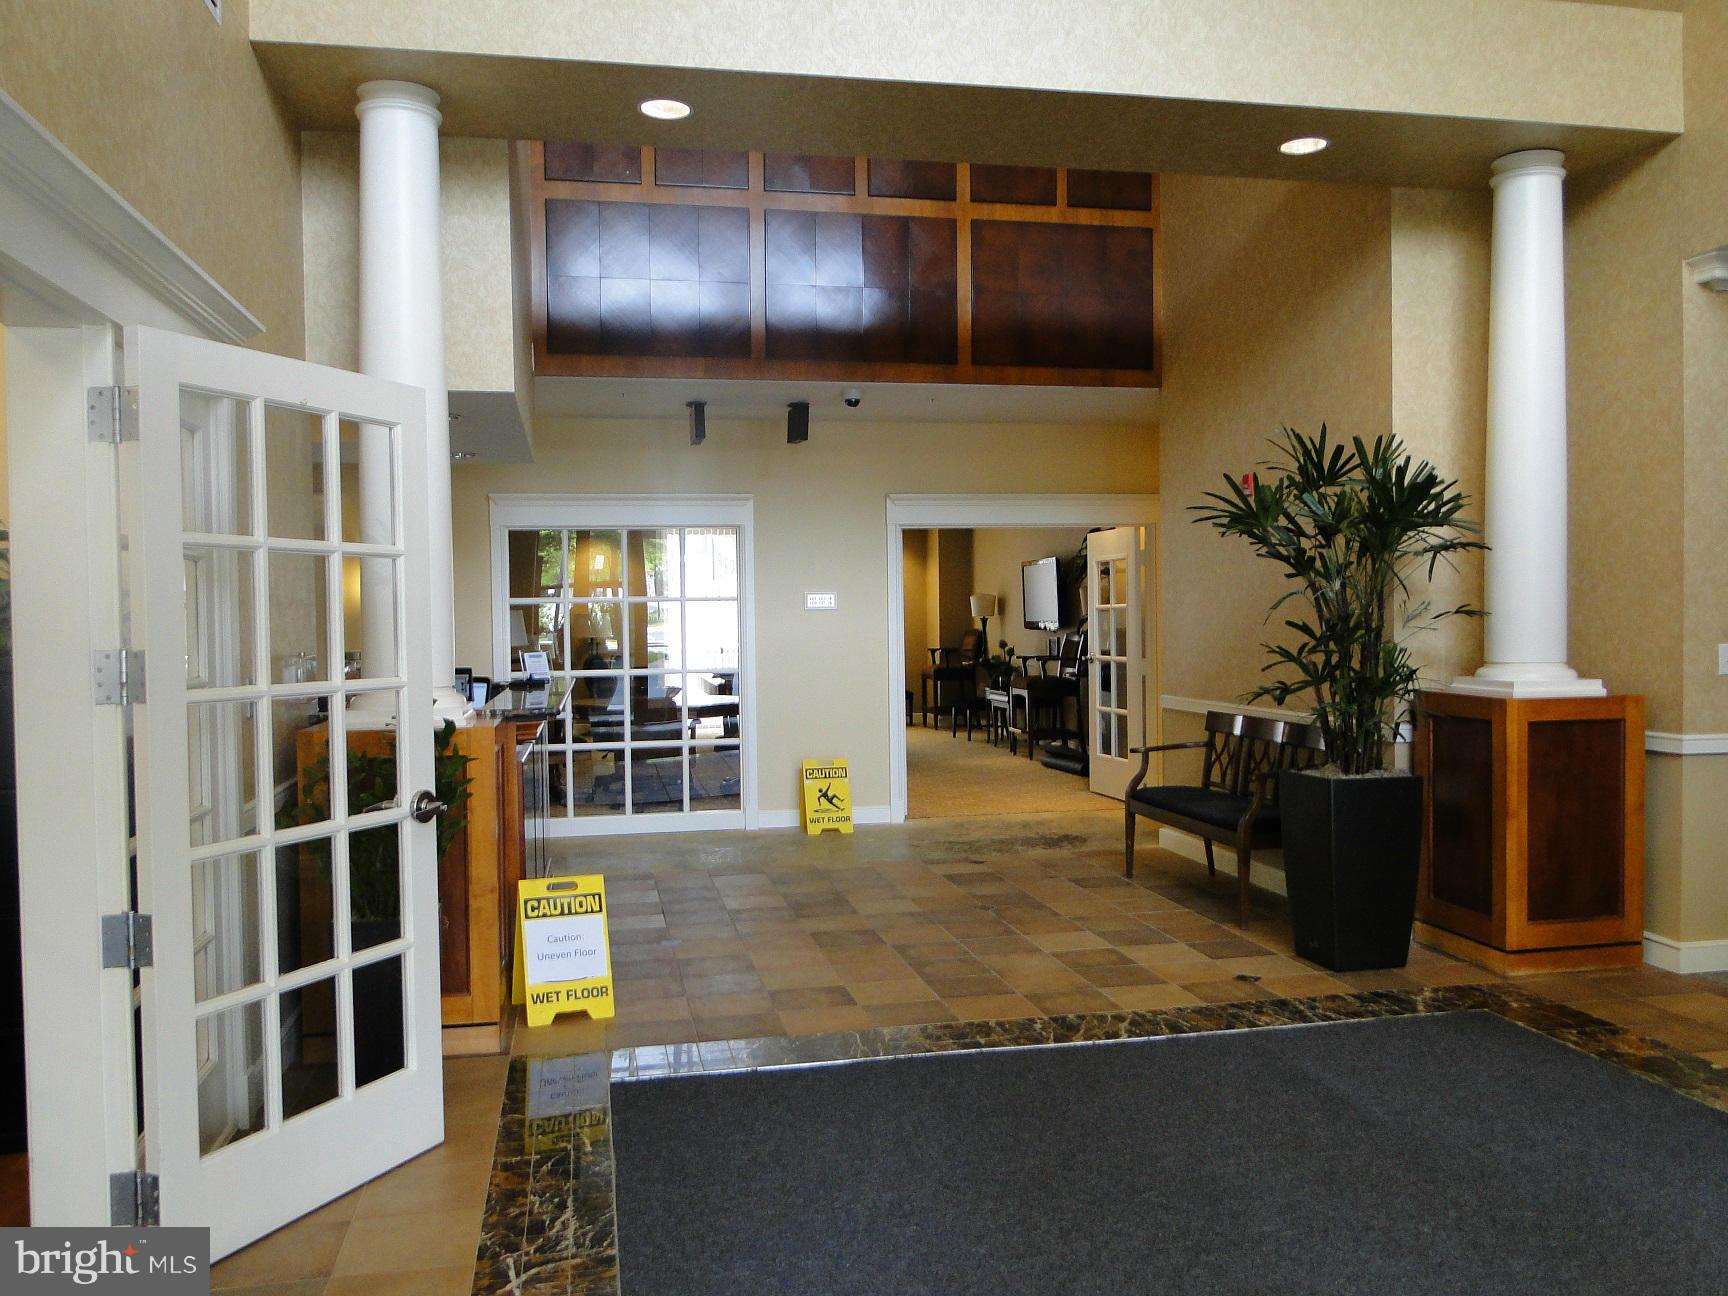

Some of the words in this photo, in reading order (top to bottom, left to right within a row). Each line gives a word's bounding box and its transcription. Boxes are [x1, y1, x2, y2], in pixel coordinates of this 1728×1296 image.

[806, 767, 846, 778] CAUTION
[526, 894, 600, 918] CAUTION
[537, 951, 572, 961] Uneven
[574, 948, 597, 957] Floor
[530, 990, 562, 1005] WET
[566, 986, 609, 1001] FLOOR
